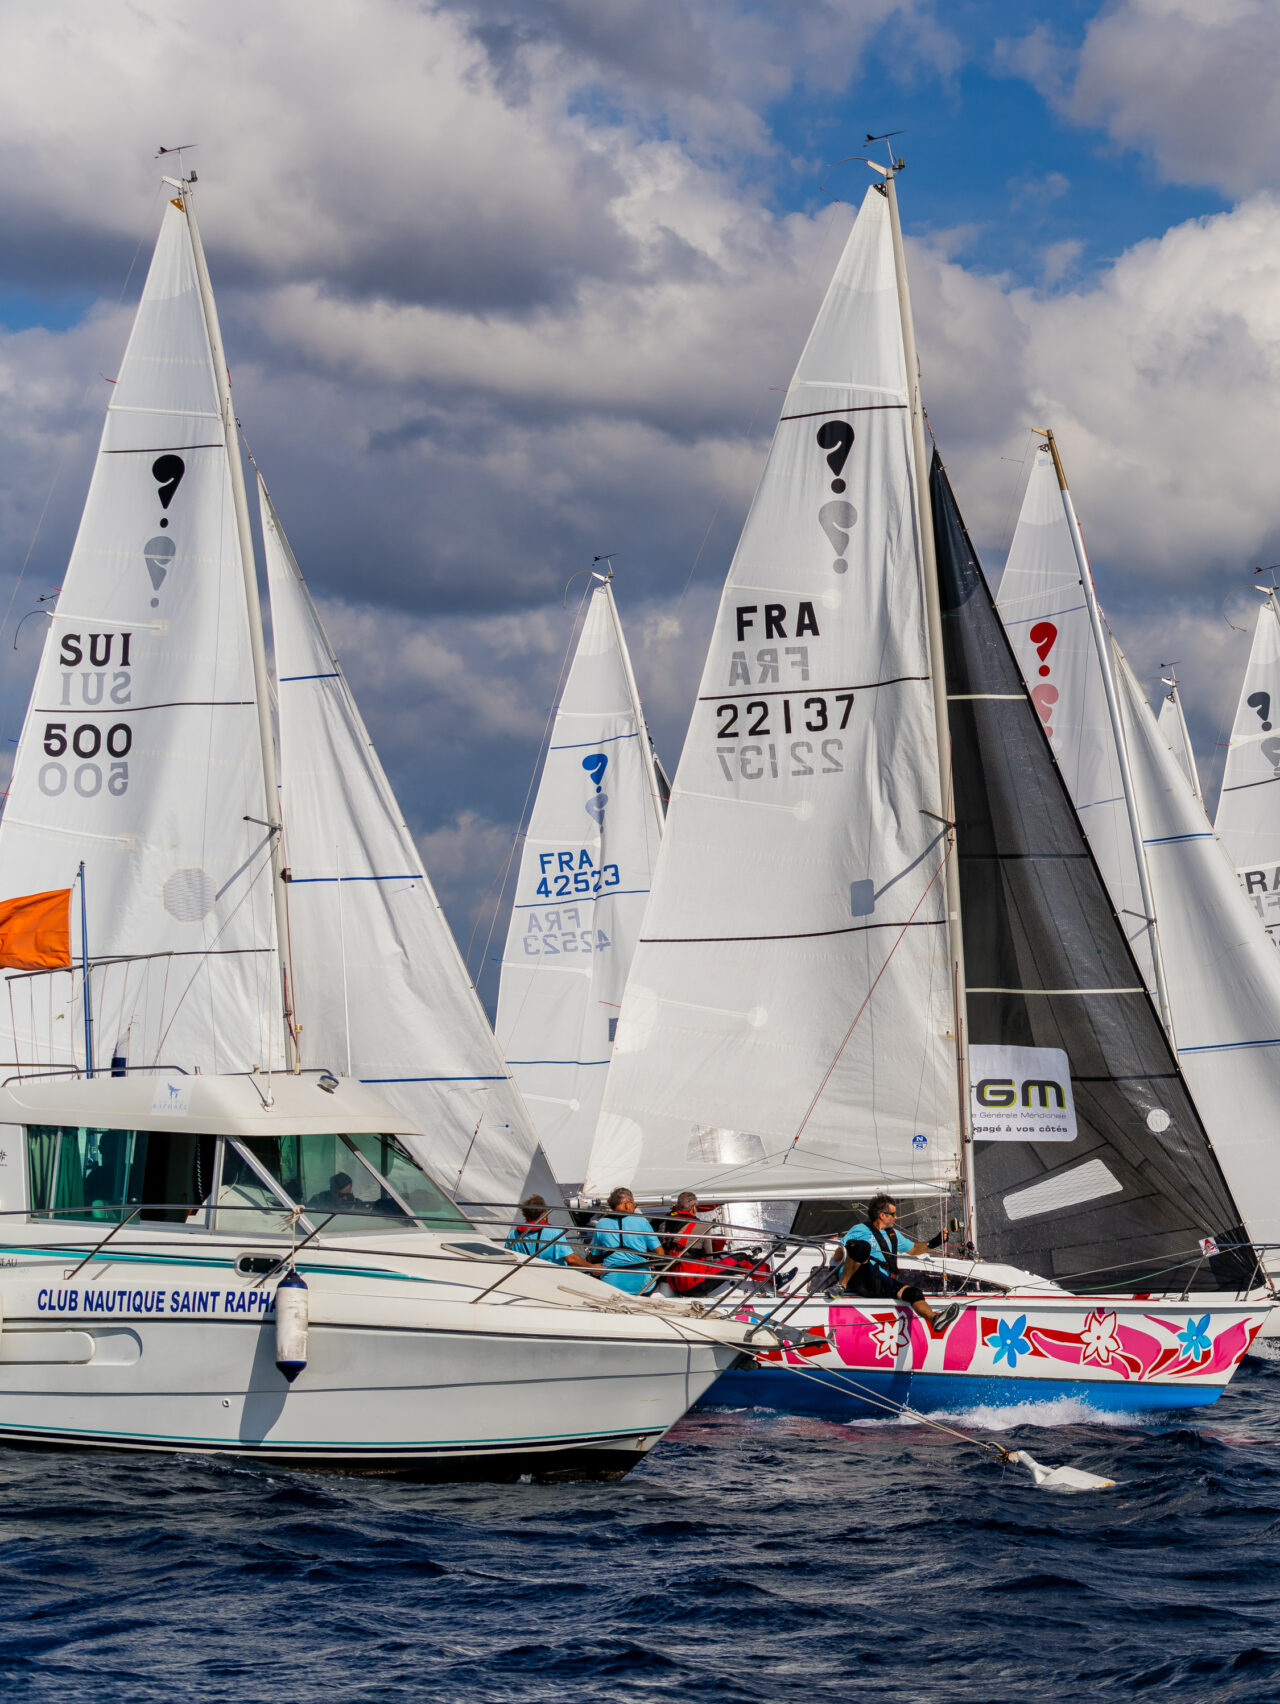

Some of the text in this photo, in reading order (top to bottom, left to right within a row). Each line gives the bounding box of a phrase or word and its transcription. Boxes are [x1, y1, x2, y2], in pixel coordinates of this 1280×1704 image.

[736, 602, 820, 641] FRA
[60, 633, 132, 667] SUI
[716, 693, 855, 738] 22137
[43, 723, 132, 758] 500
[539, 849, 593, 874] FRA
[536, 864, 620, 898] 42523
[973, 1125, 1001, 1133] gagé
[980, 1111, 1017, 1119] Générale
[0, 1257, 18, 1267] EAU
[37, 1289, 78, 1311] CLUB
[83, 1290, 166, 1313] NAUTIQUE
[170, 1291, 220, 1312] SAINT
